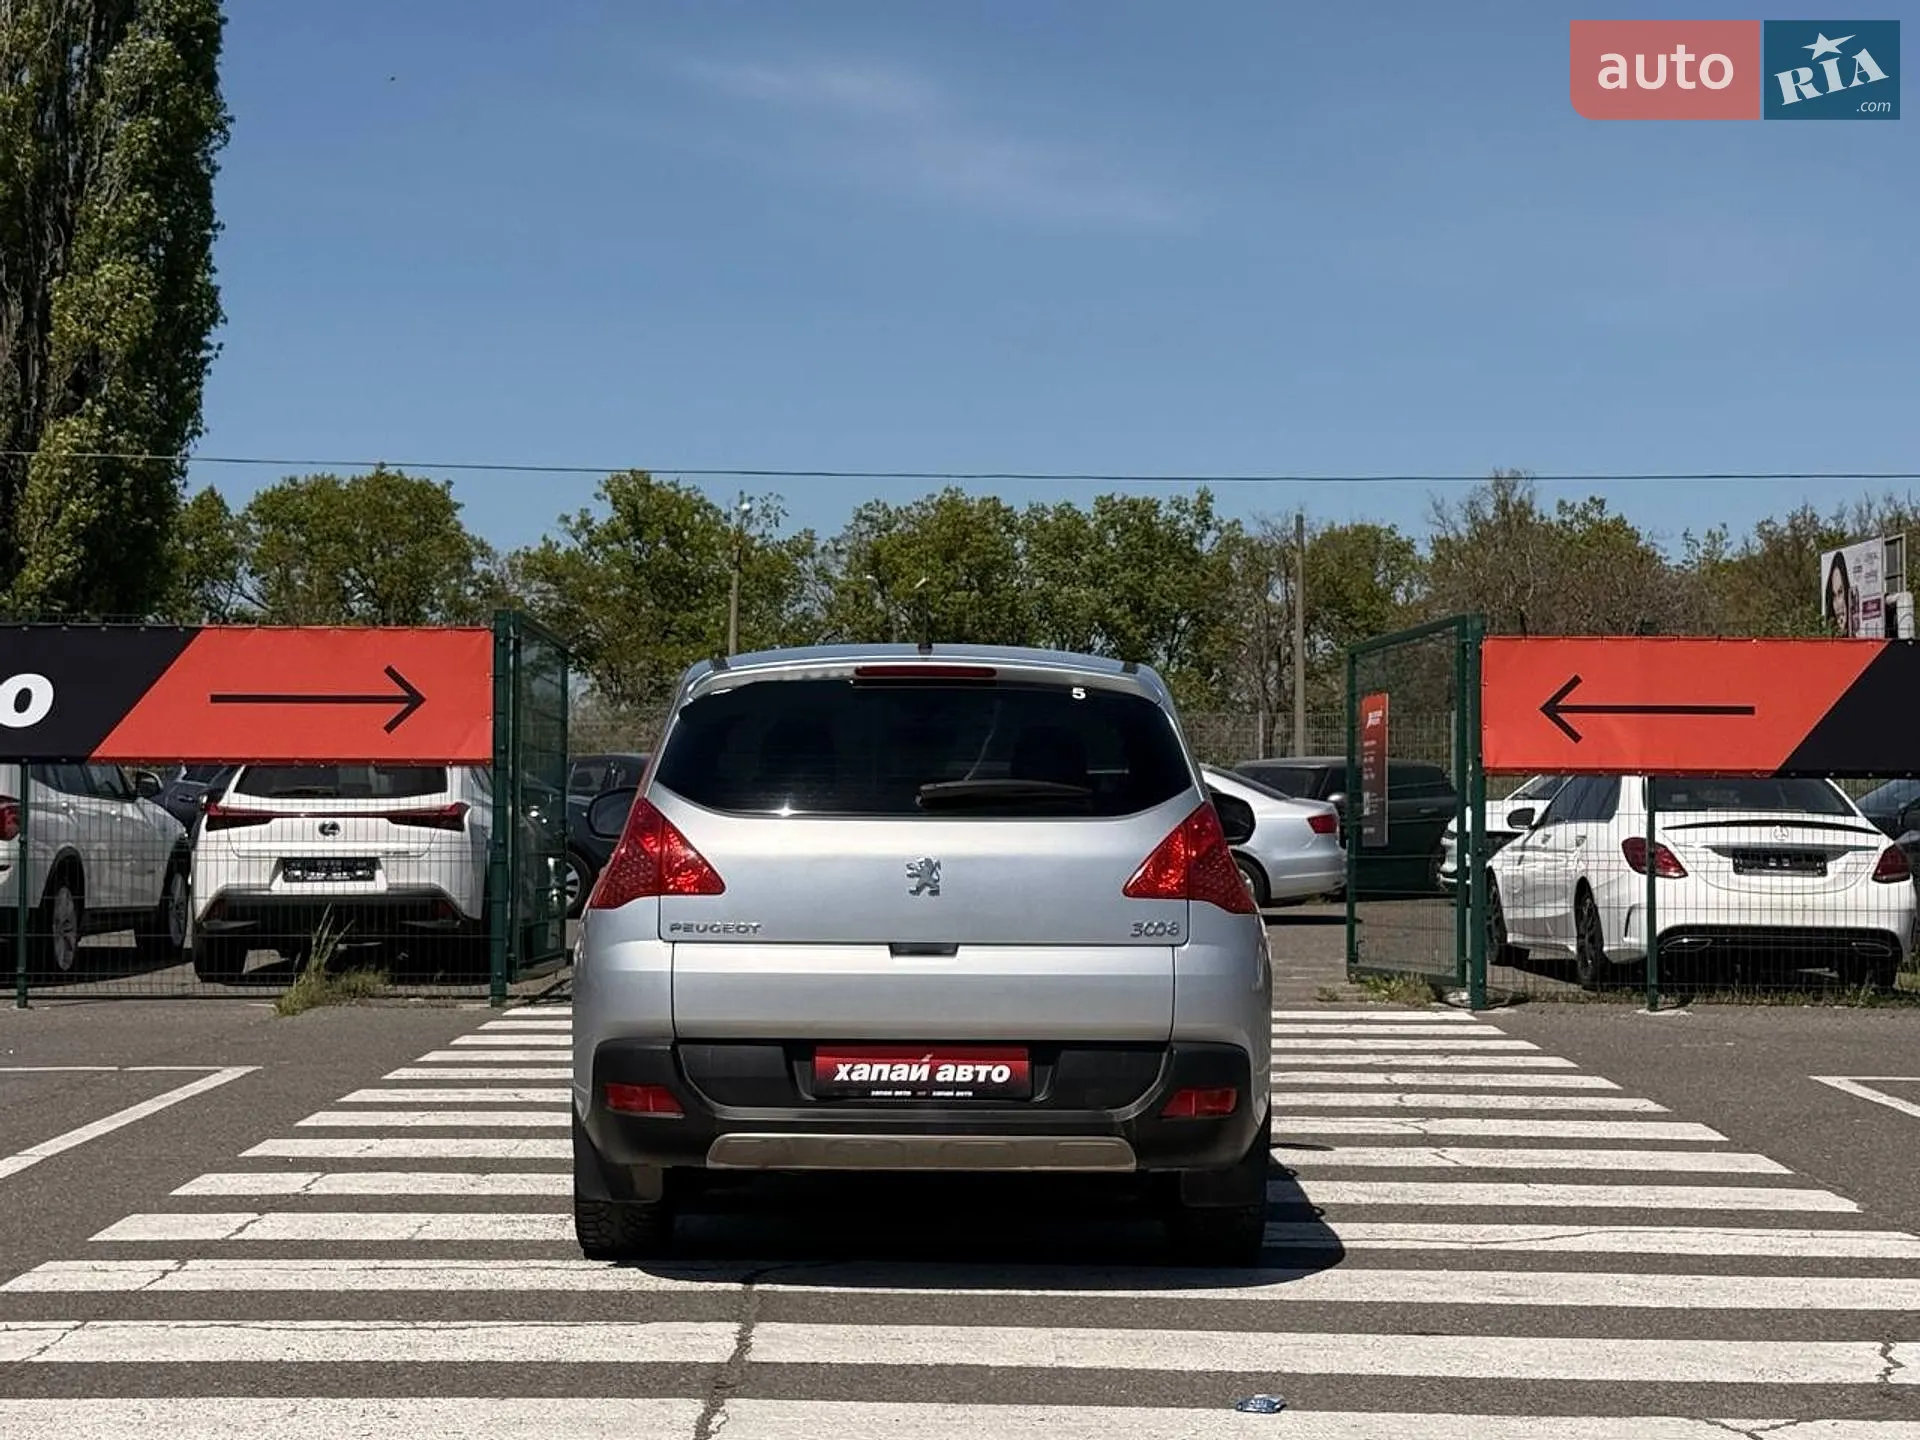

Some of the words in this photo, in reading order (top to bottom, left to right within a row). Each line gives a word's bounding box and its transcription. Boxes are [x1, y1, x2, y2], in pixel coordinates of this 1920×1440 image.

[1072, 687, 1086, 700] 5
[669, 922, 762, 935] PEUGEOT
[1129, 922, 1180, 938] 3008
[935, 1063, 1012, 1083] авто
